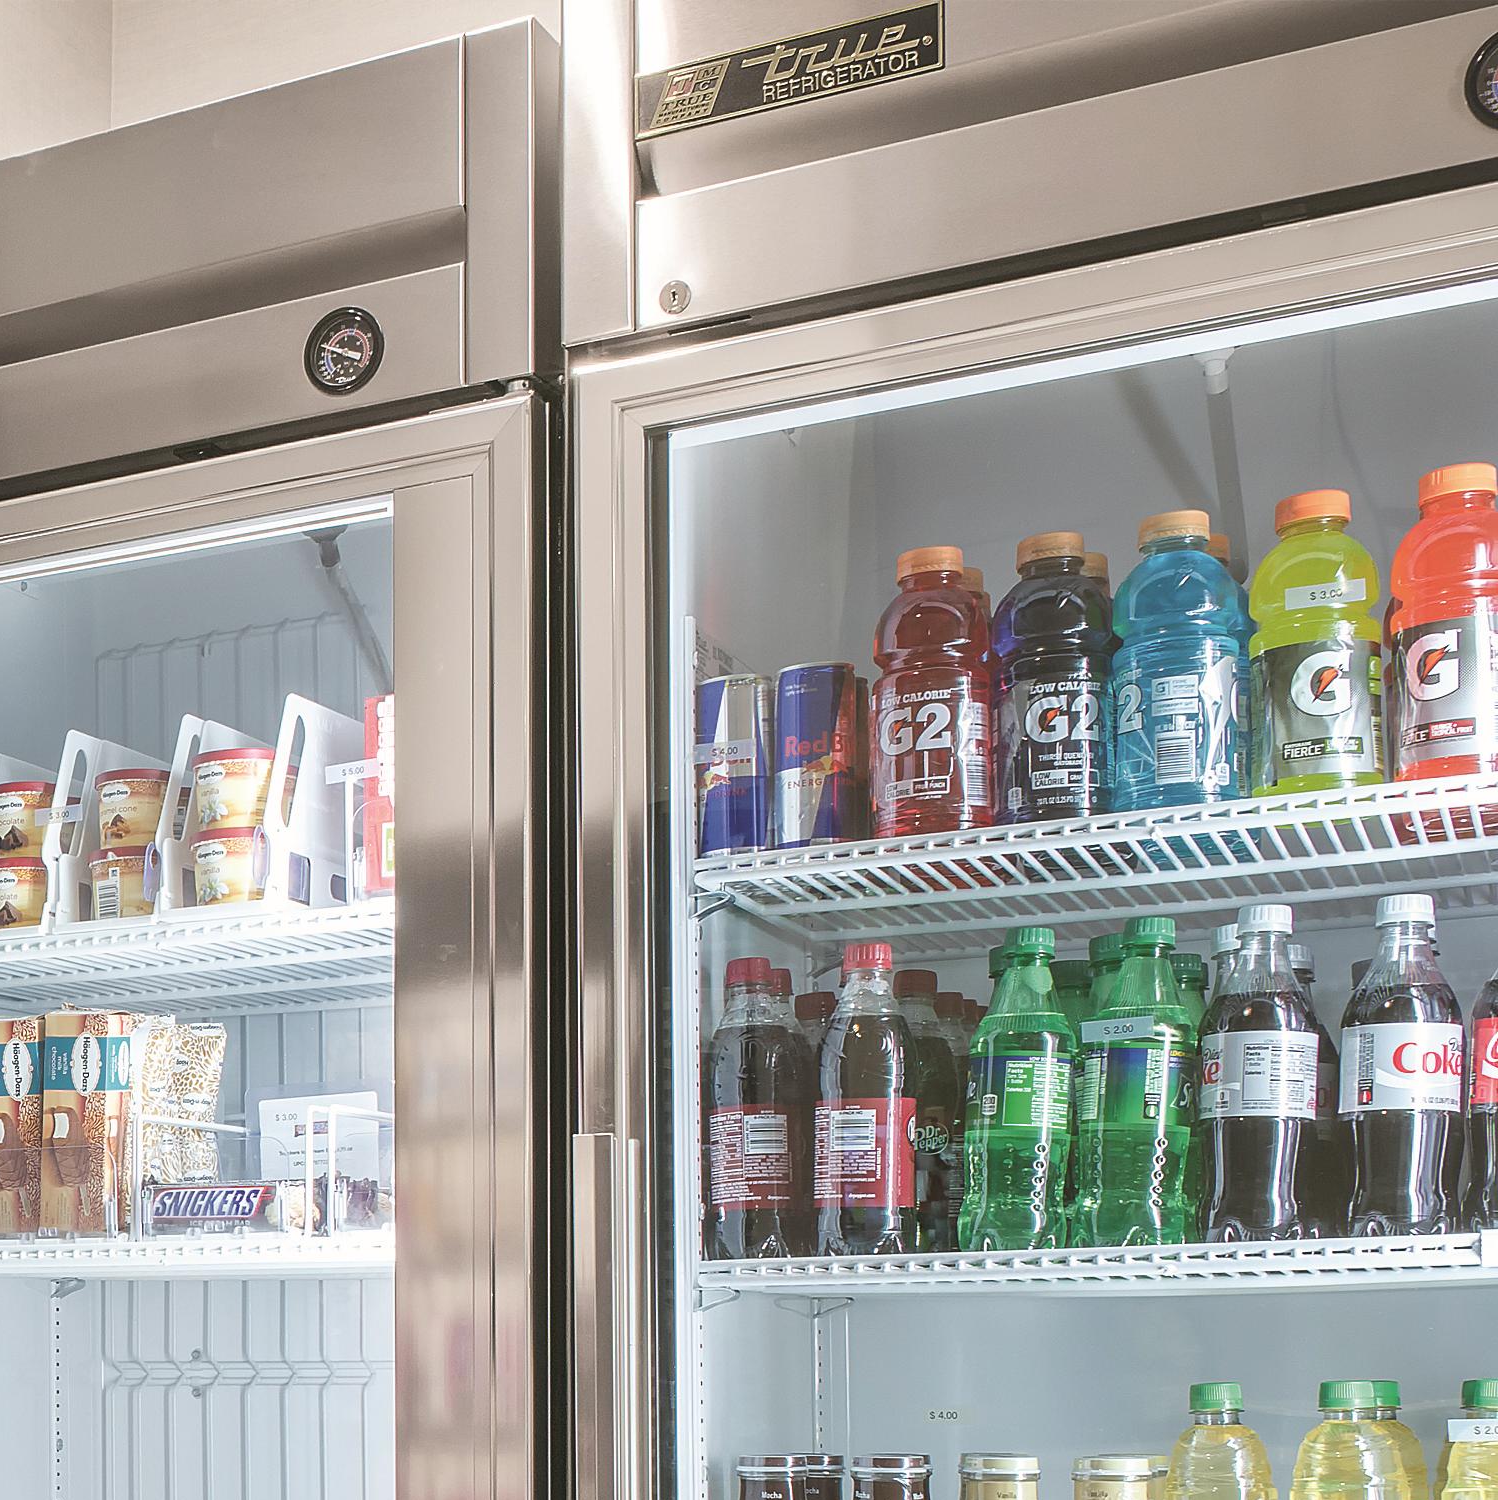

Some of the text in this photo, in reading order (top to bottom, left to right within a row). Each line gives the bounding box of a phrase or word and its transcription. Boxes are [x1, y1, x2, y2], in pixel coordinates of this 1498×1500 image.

[741, 24, 920, 83] true
[762, 51, 919, 103] REFRIGERATOR
[1407, 628, 1462, 701] G
[881, 690, 950, 708] LOW CALORIE
[1030, 681, 1100, 693] LOW CALORIE
[1291, 650, 1352, 717] G
[881, 703, 951, 756] G2
[1025, 697, 1099, 744] G2
[1284, 746, 1322, 759] FIERCE
[1104, 1024, 1133, 1035] $ 2.00
[1392, 1042, 1462, 1076] Coke
[914, 1127, 947, 1151] Pepper
[154, 1189, 259, 1217] SNICKERS
[762, 1491, 782, 1500] Mocha
